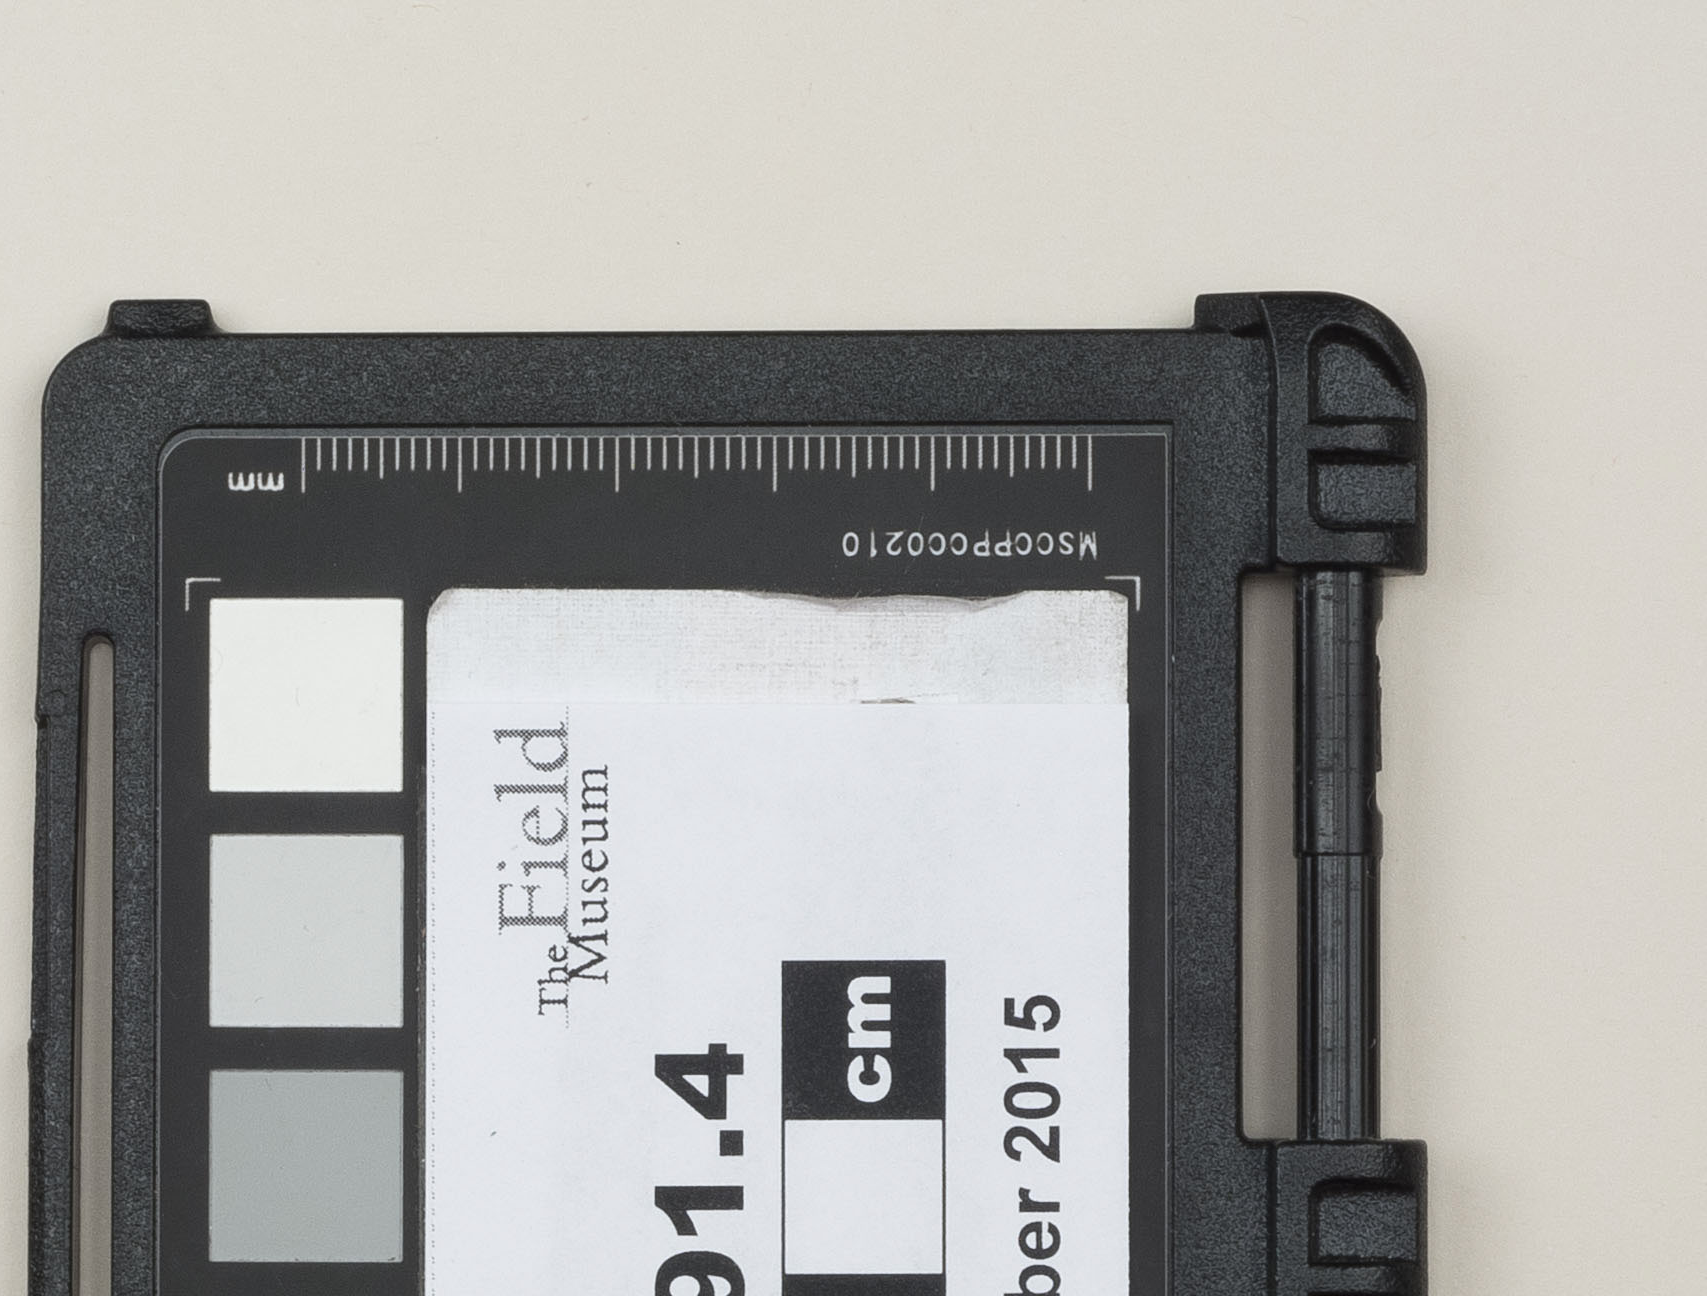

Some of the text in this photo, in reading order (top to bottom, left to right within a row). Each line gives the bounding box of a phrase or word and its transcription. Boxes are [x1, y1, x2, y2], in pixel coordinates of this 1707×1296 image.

[228, 472, 287, 494] mm
[492, 720, 569, 1020] The Field
[566, 763, 609, 985] Museum
[845, 975, 893, 1104] cm
[1002, 994, 1063, 1164] 2015
